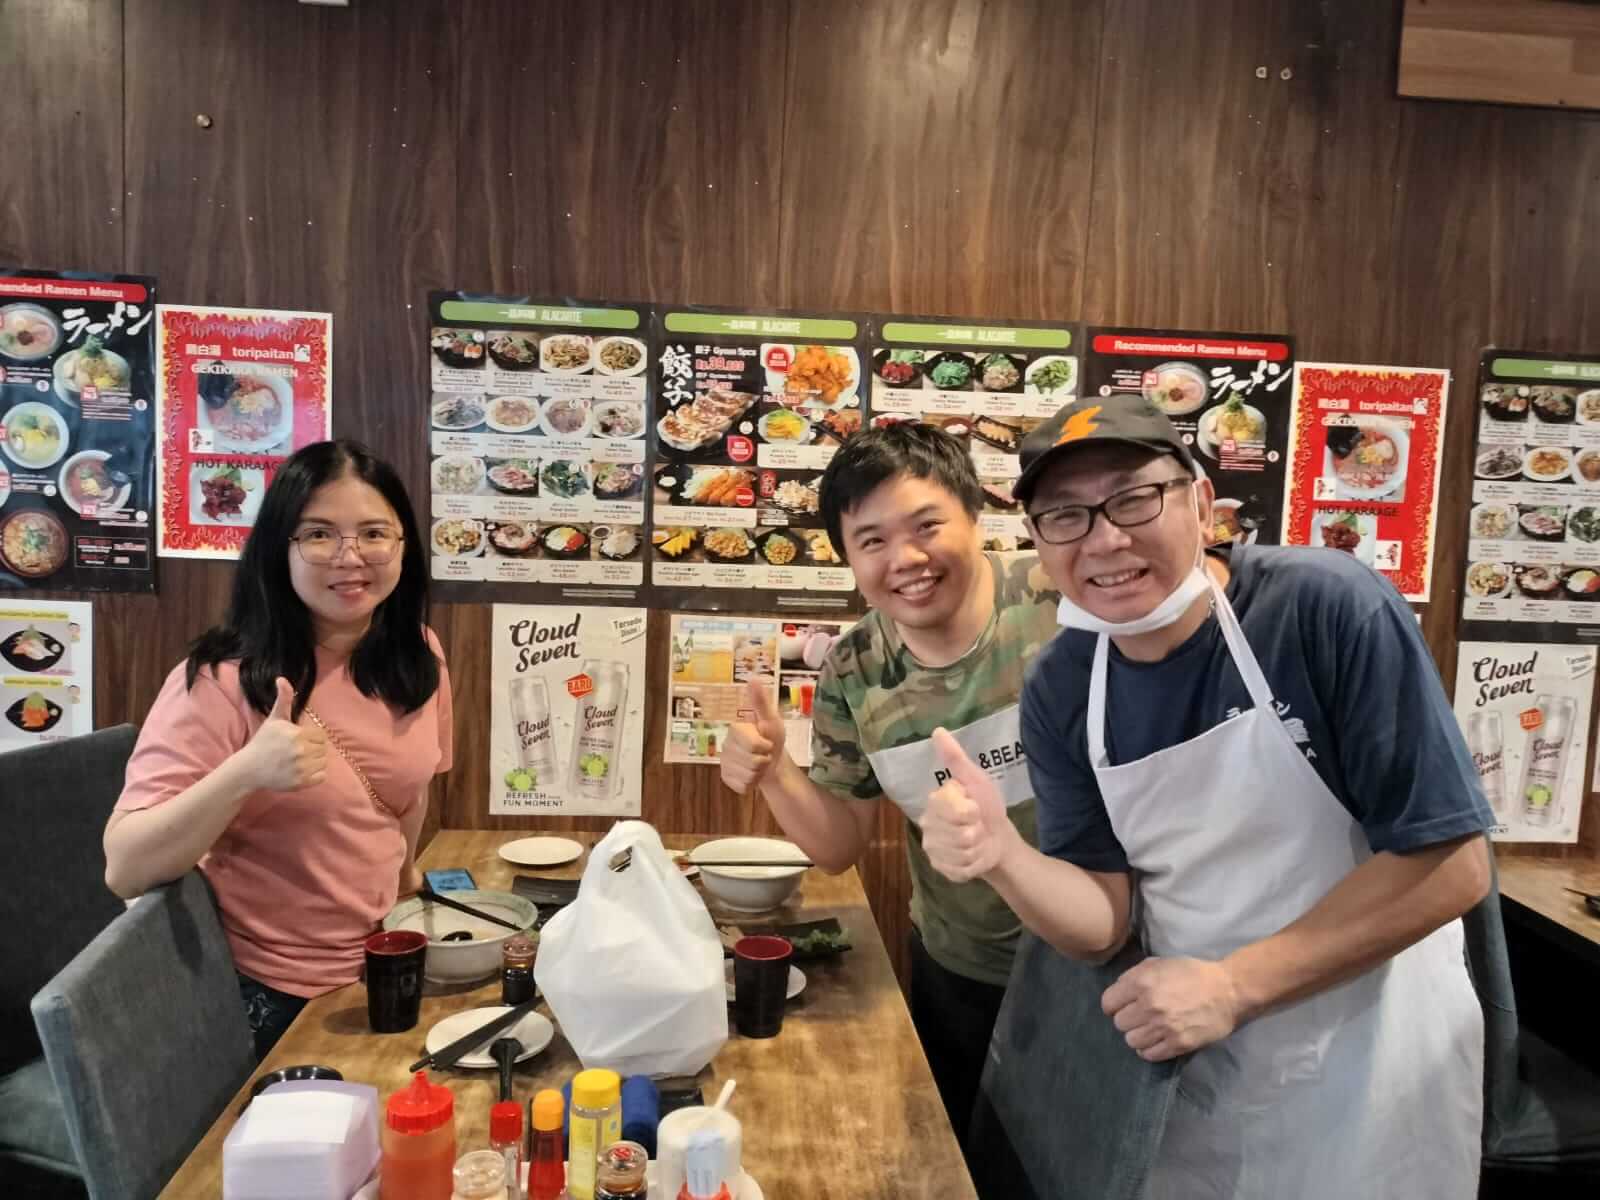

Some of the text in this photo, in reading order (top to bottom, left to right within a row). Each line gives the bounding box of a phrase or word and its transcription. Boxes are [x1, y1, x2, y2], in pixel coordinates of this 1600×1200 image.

[45, 284, 87, 296] Ramen
[89, 286, 124, 298] Menu
[62, 301, 153, 343] ラーメン
[232, 346, 294, 360] toripaitan
[659, 344, 694, 406] 餃子
[196, 457, 280, 471] HOT KARAAG
[509, 613, 581, 647] Cloud
[515, 642, 580, 673] Seven
[1472, 651, 1538, 683] Cloud
[1476, 677, 1534, 707] Seven
[584, 704, 618, 721] Cloud
[517, 713, 550, 737] Cloud
[584, 719, 615, 732] Seven
[521, 730, 551, 751] Seven
[503, 799, 521, 807] FUN
[505, 791, 547, 800] REFRESH
